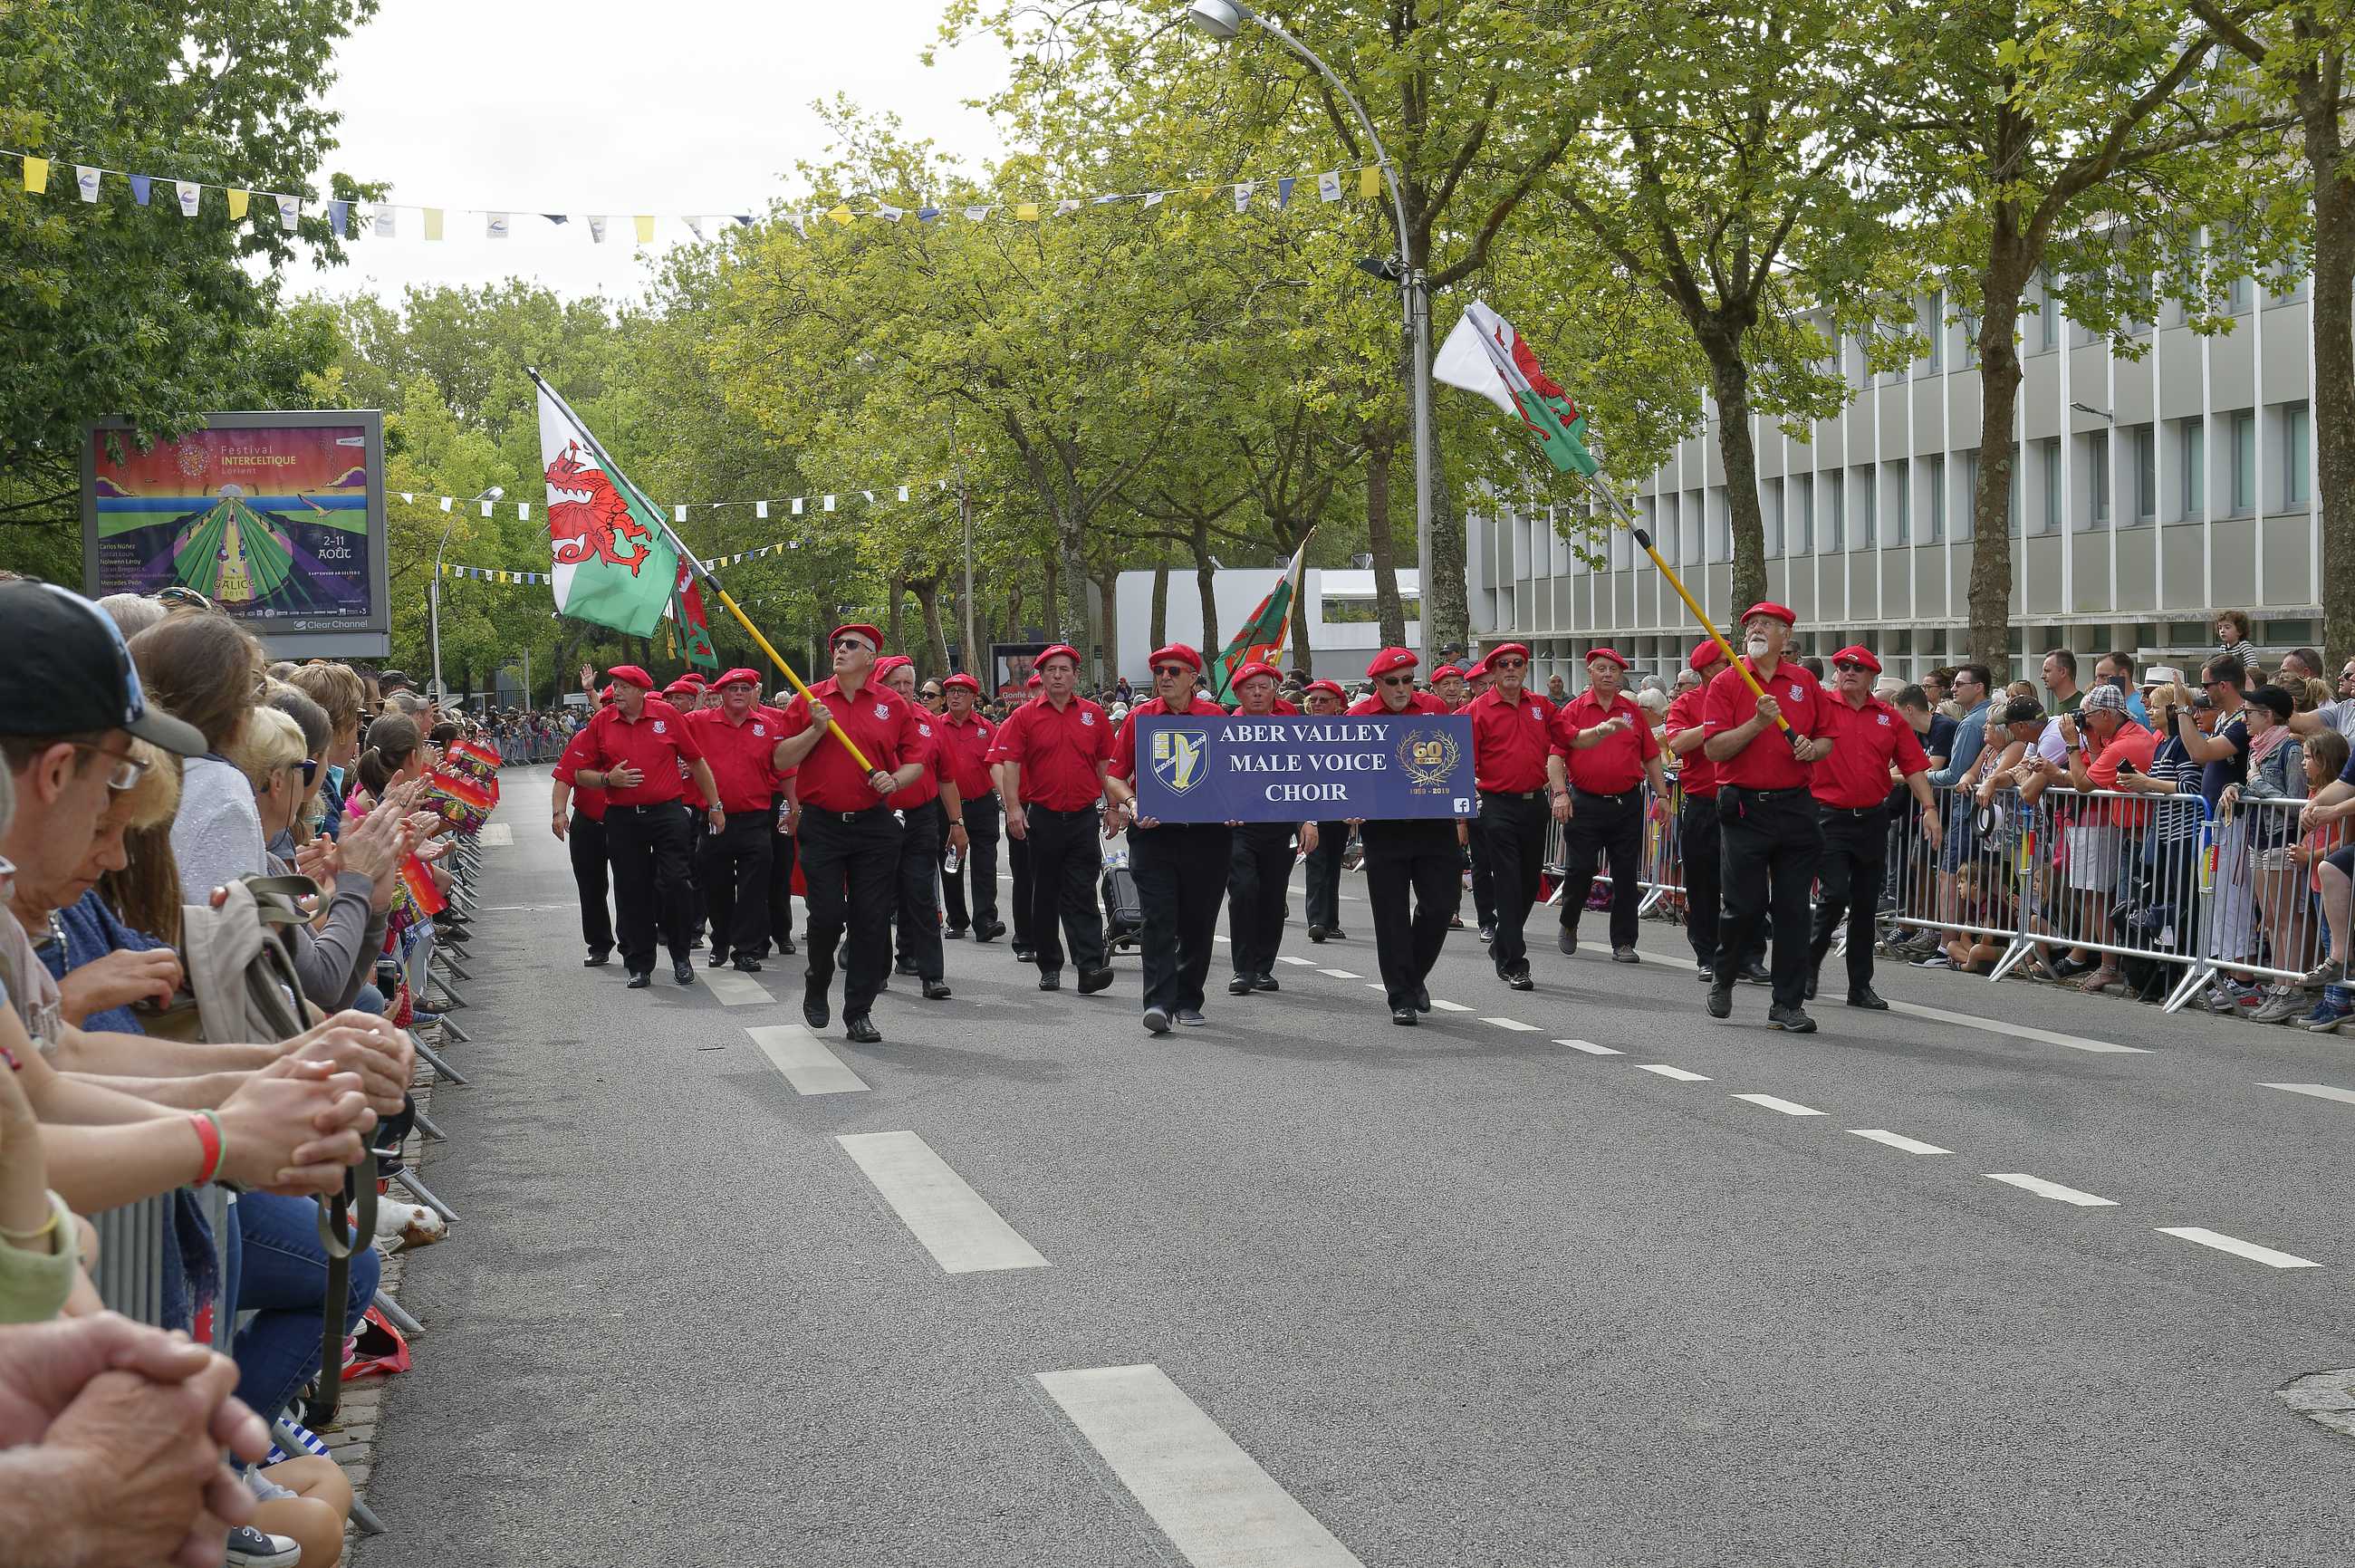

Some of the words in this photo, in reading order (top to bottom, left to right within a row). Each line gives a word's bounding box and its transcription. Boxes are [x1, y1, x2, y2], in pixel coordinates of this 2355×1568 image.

[221, 445, 273, 455] Festival
[221, 456, 296, 467] INTERCELTIQUE
[323, 535, 344, 546] 2-11
[213, 578, 255, 590] GALICE
[332, 620, 368, 629] Channel
[1219, 725, 1286, 743] ABER
[1291, 724, 1389, 742] VALLEY
[1412, 741, 1443, 758] 60
[1229, 755, 1302, 773] MALE
[1306, 754, 1388, 772] VOICE
[1264, 783, 1349, 803] CHOIR
